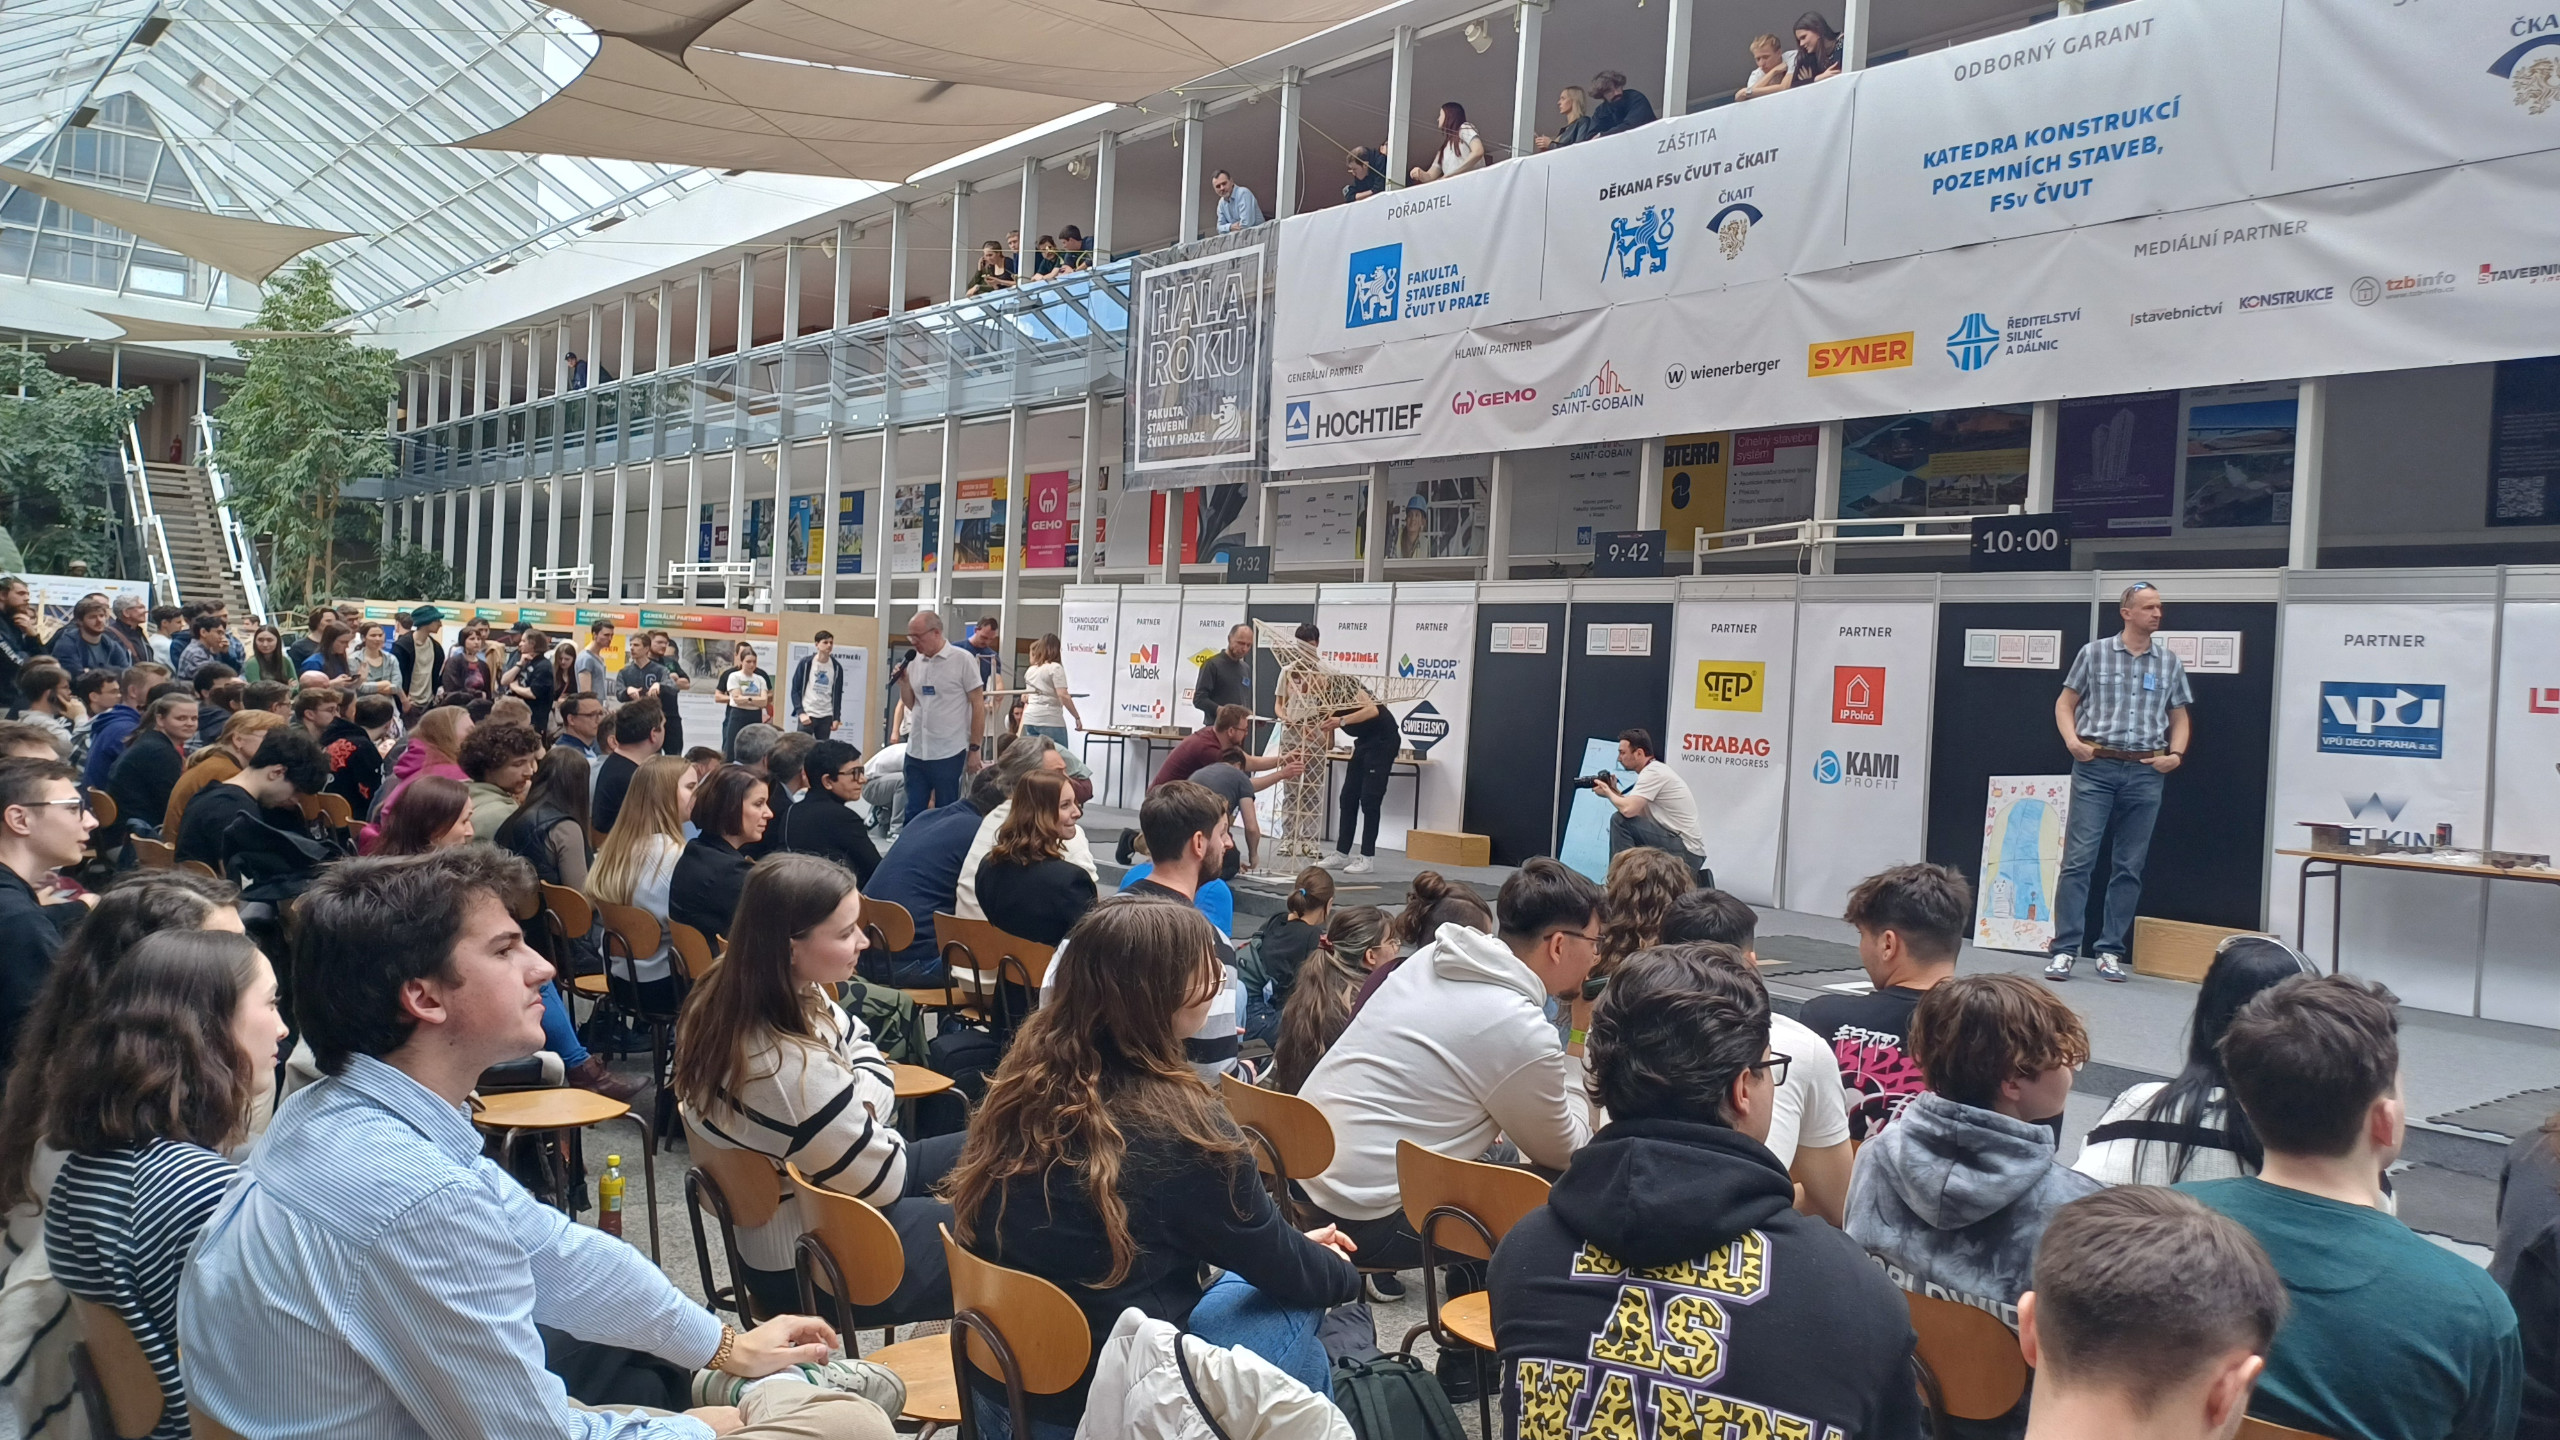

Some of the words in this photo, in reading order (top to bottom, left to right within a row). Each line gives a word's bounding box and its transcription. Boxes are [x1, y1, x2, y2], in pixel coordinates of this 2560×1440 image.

[2510, 14, 2560, 37] ČKA
[1954, 39, 2056, 82] ODBORNÝ
[2062, 18, 2155, 55] GARANT
[1657, 127, 1717, 155] ZÁŠTITA
[1923, 134, 2018, 170] KATEDRA
[2024, 94, 2182, 148] KONSTRUKCÍ
[1599, 178, 1653, 201] DĚKANA
[1656, 172, 1681, 189] FSv
[1684, 161, 1722, 182] ČVUT
[1723, 162, 1733, 173] a
[1736, 148, 1780, 170] ČKAIT
[1932, 154, 2061, 195] POZEMNÍCH
[2067, 136, 2164, 170] STAVEB,
[1718, 186, 1755, 204] ČKAIT
[1989, 192, 2028, 213] FSv
[2033, 178, 2094, 205] ČVUT
[1387, 194, 1453, 221] POŘADATEL
[2134, 229, 2219, 257] MEDIÁLNÍ
[2223, 220, 2308, 245] PARTNER
[1407, 264, 1459, 286] FAKULTA
[2385, 271, 2456, 291] tzbinfo
[2478, 264, 2560, 285] STAVEBNI
[1405, 276, 1467, 302] STAVEBNÍ
[2239, 287, 2334, 309] KONSTRUKCE
[1151, 272, 1247, 336] HALA
[1404, 303, 1435, 319] ČVUT
[1439, 300, 1447, 312] V
[1449, 292, 1490, 311] PRAZE
[2007, 307, 2082, 330] ŘEDITELSTVÍ
[2134, 302, 2223, 325] stavebnictví
[2006, 328, 2043, 343] SILNIC
[1455, 343, 1488, 360] HLAVNÍ
[1489, 340, 1533, 356] PARTNER
[1814, 340, 1907, 370] SYNER
[2005, 345, 2014, 355] A
[2016, 339, 2059, 354] DÁLNIC
[1148, 326, 1247, 388] ROKU
[1287, 367, 1328, 384] GENERÁLNÍ
[1328, 364, 1364, 378] PARTNER
[1690, 358, 1781, 380] wienerberger
[1477, 388, 1537, 406] GEMO
[1552, 394, 1644, 416] SAINT-GOBAIN
[1147, 405, 1184, 421] FAKULTA
[1316, 403, 1423, 439] HOCHTIEF
[1147, 417, 1189, 434] STAVEBNÍ
[1146, 433, 1169, 448] ČVUT
[1169, 434, 1177, 445] V
[1177, 431, 1206, 444] PRAZE
[1570, 447, 1632, 461] SAINT-GOBAIN
[1663, 441, 1720, 468] BTERRA
[1031, 520, 1063, 531] GEMO
[1983, 528, 2058, 554] 10:00
[990, 555, 1004, 563] SYN
[1608, 543, 1650, 562] 9:42
[1235, 556, 1260, 572] 9:32
[643, 612, 676, 621] GENERÁLNÍ
[1069, 615, 1109, 625] TECHNOLOGICKÝ
[1136, 618, 1161, 626] PARTNER
[1200, 620, 1225, 628] PARTNER
[1338, 622, 1368, 631] PARTNER
[1415, 622, 1448, 632] PARTNER
[1711, 623, 1758, 634] PARTNER
[1839, 626, 1892, 638] PARTNER
[1067, 642, 1094, 654] ViewSonic
[2343, 634, 2425, 648] PARTNER
[1333, 651, 1379, 663] PODZIMEK
[1417, 658, 1457, 669] SUDOP
[1130, 664, 1160, 680] Valbek
[1416, 669, 1456, 680] PRAHA
[1121, 704, 1150, 713] VINCI
[1840, 709, 1850, 719] IP
[1850, 709, 1875, 721] Polná
[1403, 718, 1446, 736] SWIETELSKY
[1682, 733, 1771, 757] STRABAG
[2321, 736, 2343, 747] VPÚ
[2345, 738, 2376, 748] DECO
[2377, 739, 2417, 750] PRAHA
[2418, 742, 2438, 751] a.s.
[1681, 753, 1706, 765] WORK
[1708, 755, 1723, 765] ON
[1724, 757, 1769, 769] PROGRESS
[1846, 751, 1900, 779] KAMI
[1844, 776, 1898, 790] PROFIT
[1587, 1284, 1732, 1389] AS
